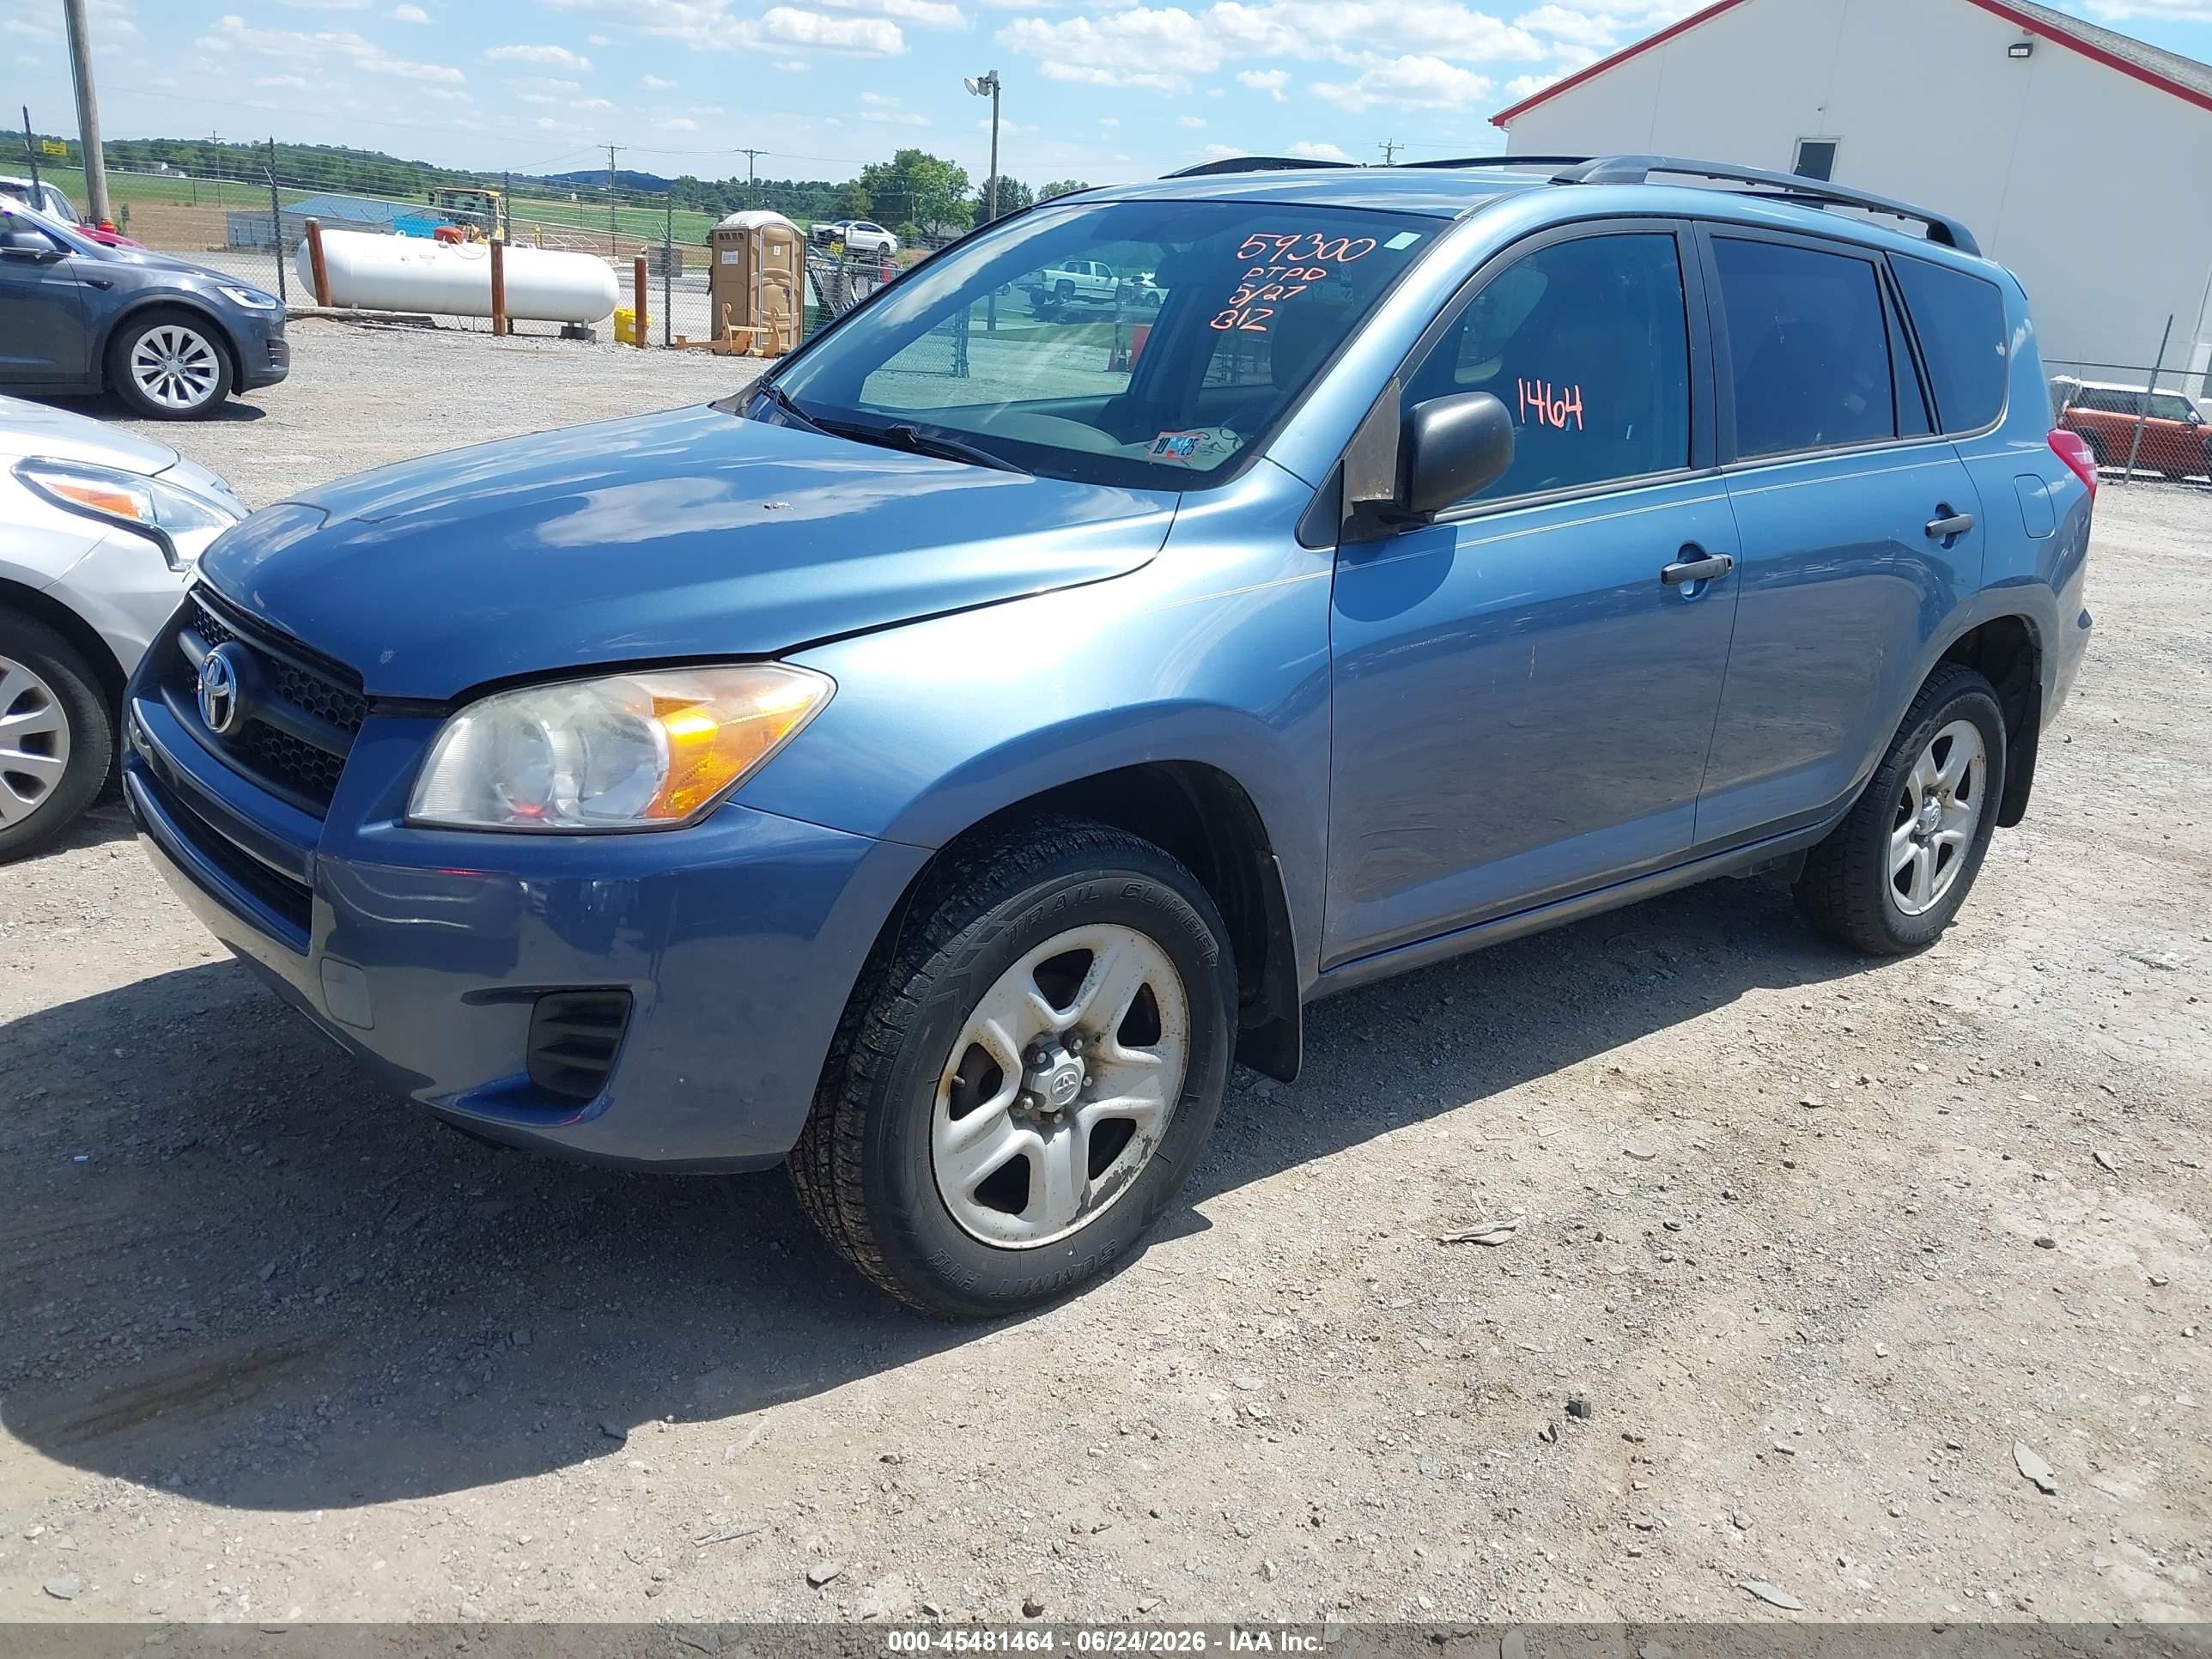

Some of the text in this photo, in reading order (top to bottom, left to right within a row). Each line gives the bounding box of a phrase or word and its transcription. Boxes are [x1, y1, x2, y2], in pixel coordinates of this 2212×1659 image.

[1237, 233, 1376, 262] 59300
[1242, 265, 1327, 281] PTPD
[1228, 283, 1307, 309] 5/27
[1517, 377, 1583, 431] 1464
[1005, 882, 1220, 968] TRAIL CLIMBER
[988, 1239, 1116, 1297] SUMMIT
